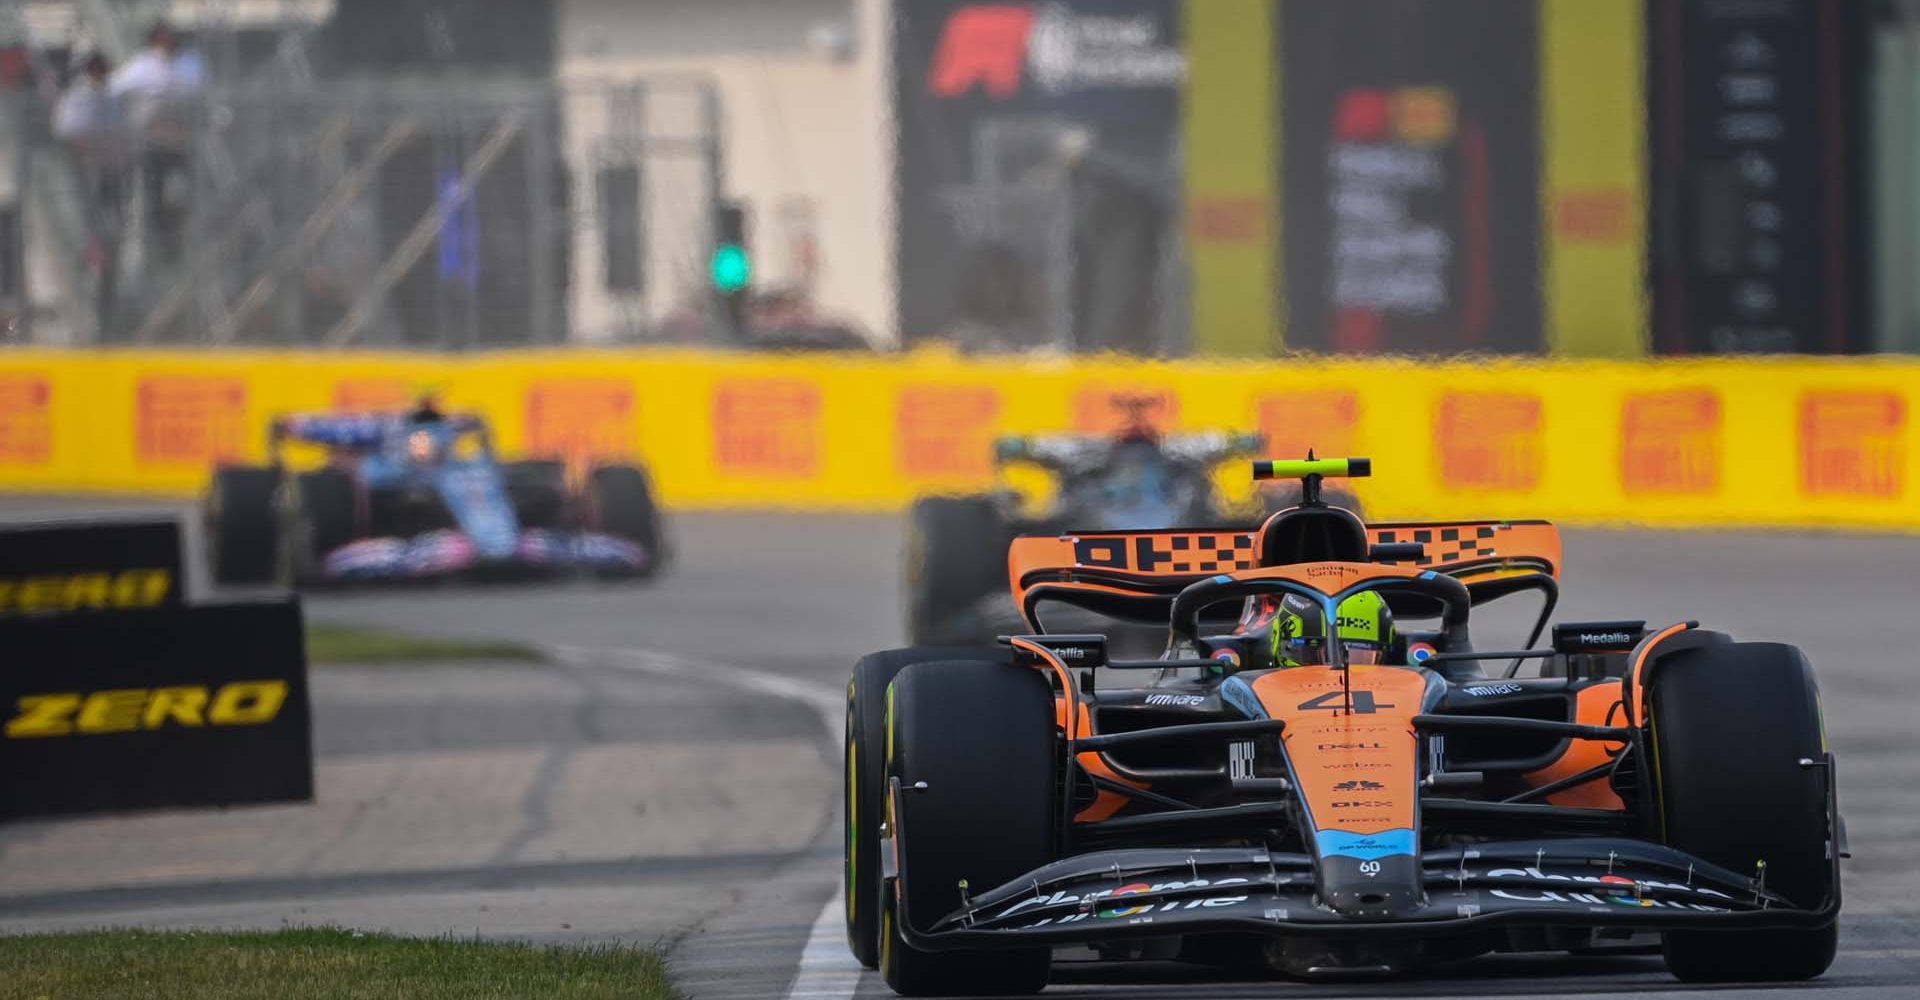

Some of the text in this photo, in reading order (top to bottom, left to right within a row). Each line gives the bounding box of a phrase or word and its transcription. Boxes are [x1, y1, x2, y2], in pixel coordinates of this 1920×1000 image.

[1075, 535, 1251, 572] OKX
[0, 569, 171, 614] ERO
[1580, 632, 1631, 645] Medallia
[1462, 682, 1523, 697] vmware
[1144, 693, 1205, 706] vmware
[1297, 690, 1395, 714] 4
[4, 679, 288, 738] ZERO
[1318, 742, 1389, 751] DELL
[1331, 800, 1393, 808] OKX
[1359, 860, 1381, 873] 60
